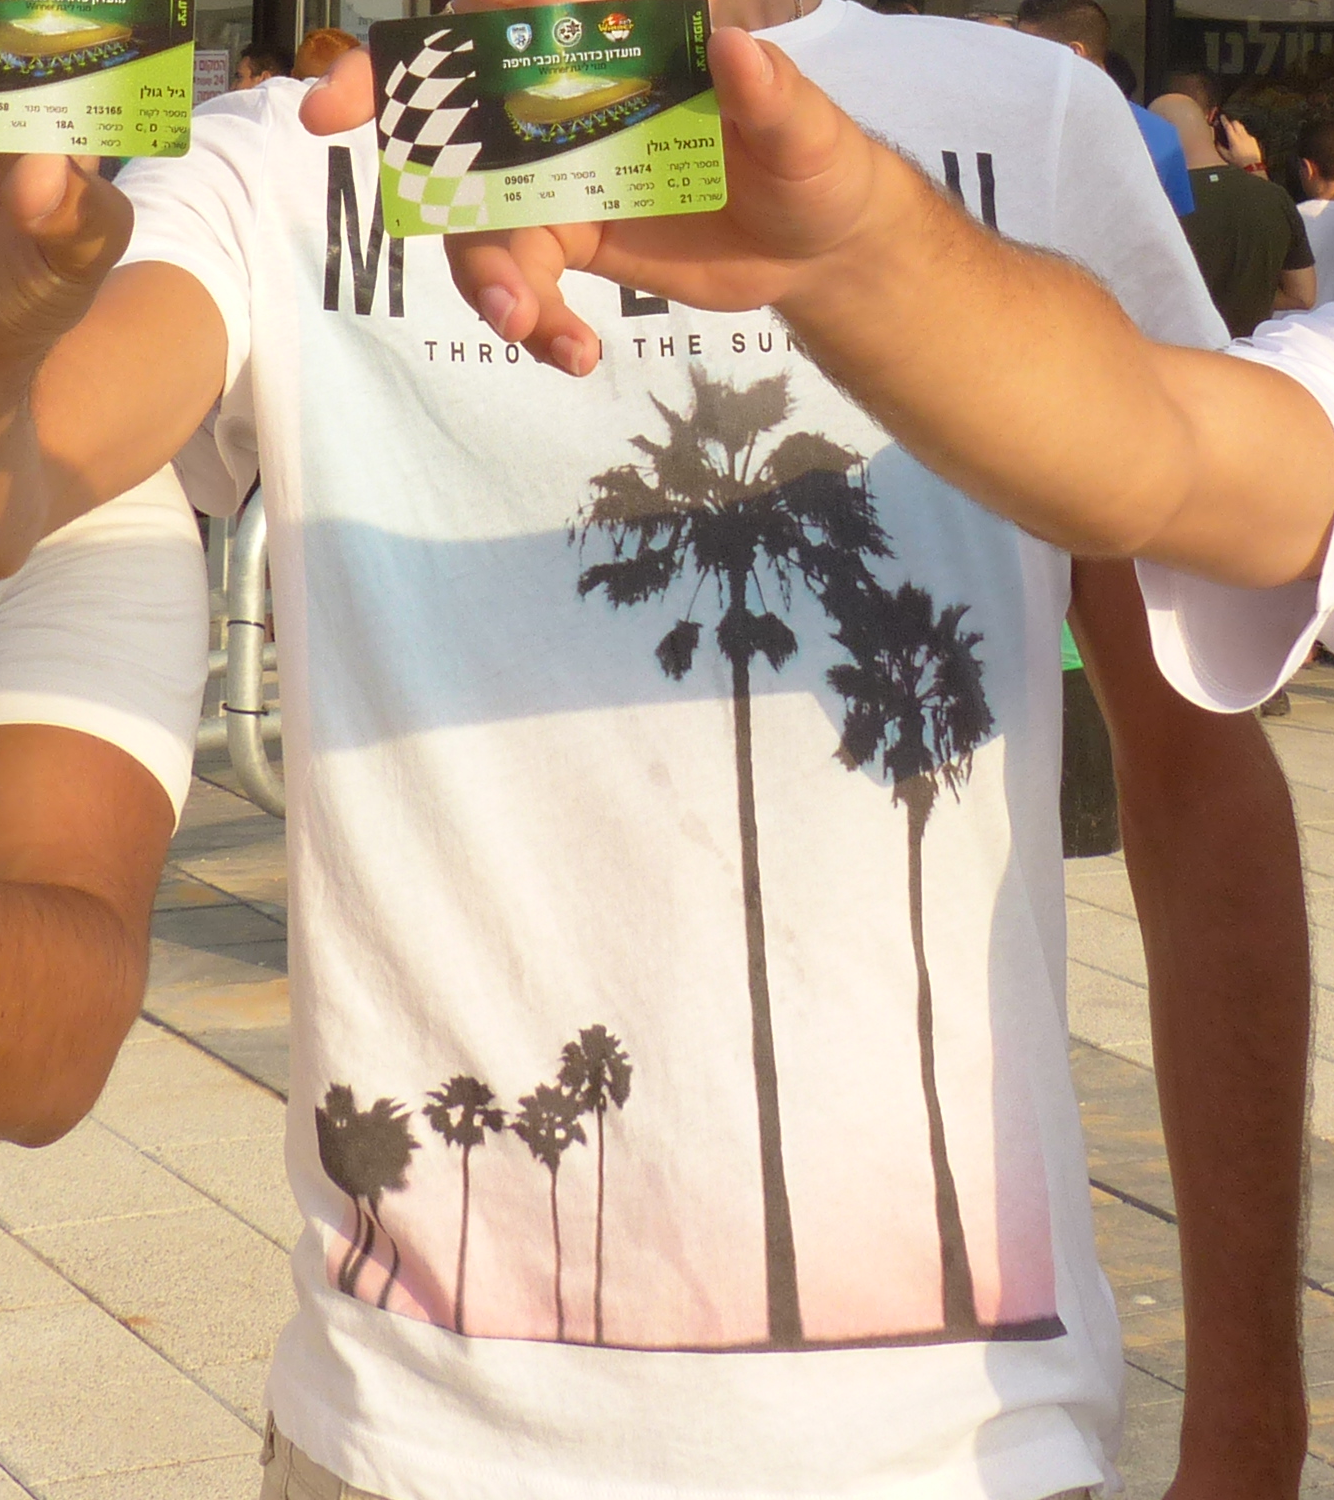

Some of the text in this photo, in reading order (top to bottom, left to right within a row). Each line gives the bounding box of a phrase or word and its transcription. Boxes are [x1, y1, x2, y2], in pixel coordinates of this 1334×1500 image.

[502, 46, 641, 70] מועדון כדורגל מכבי חיפה
[140, 86, 186, 99] גיל גולן
[646, 136, 715, 156] נתנאל גולן
[615, 163, 652, 176] 211474
[503, 192, 522, 202] 105
[584, 185, 605, 196] 18A
[603, 200, 620, 210] 138
[680, 194, 692, 204] 21
[424, 339, 603, 365] THRO
[632, 333, 703, 359] THE
